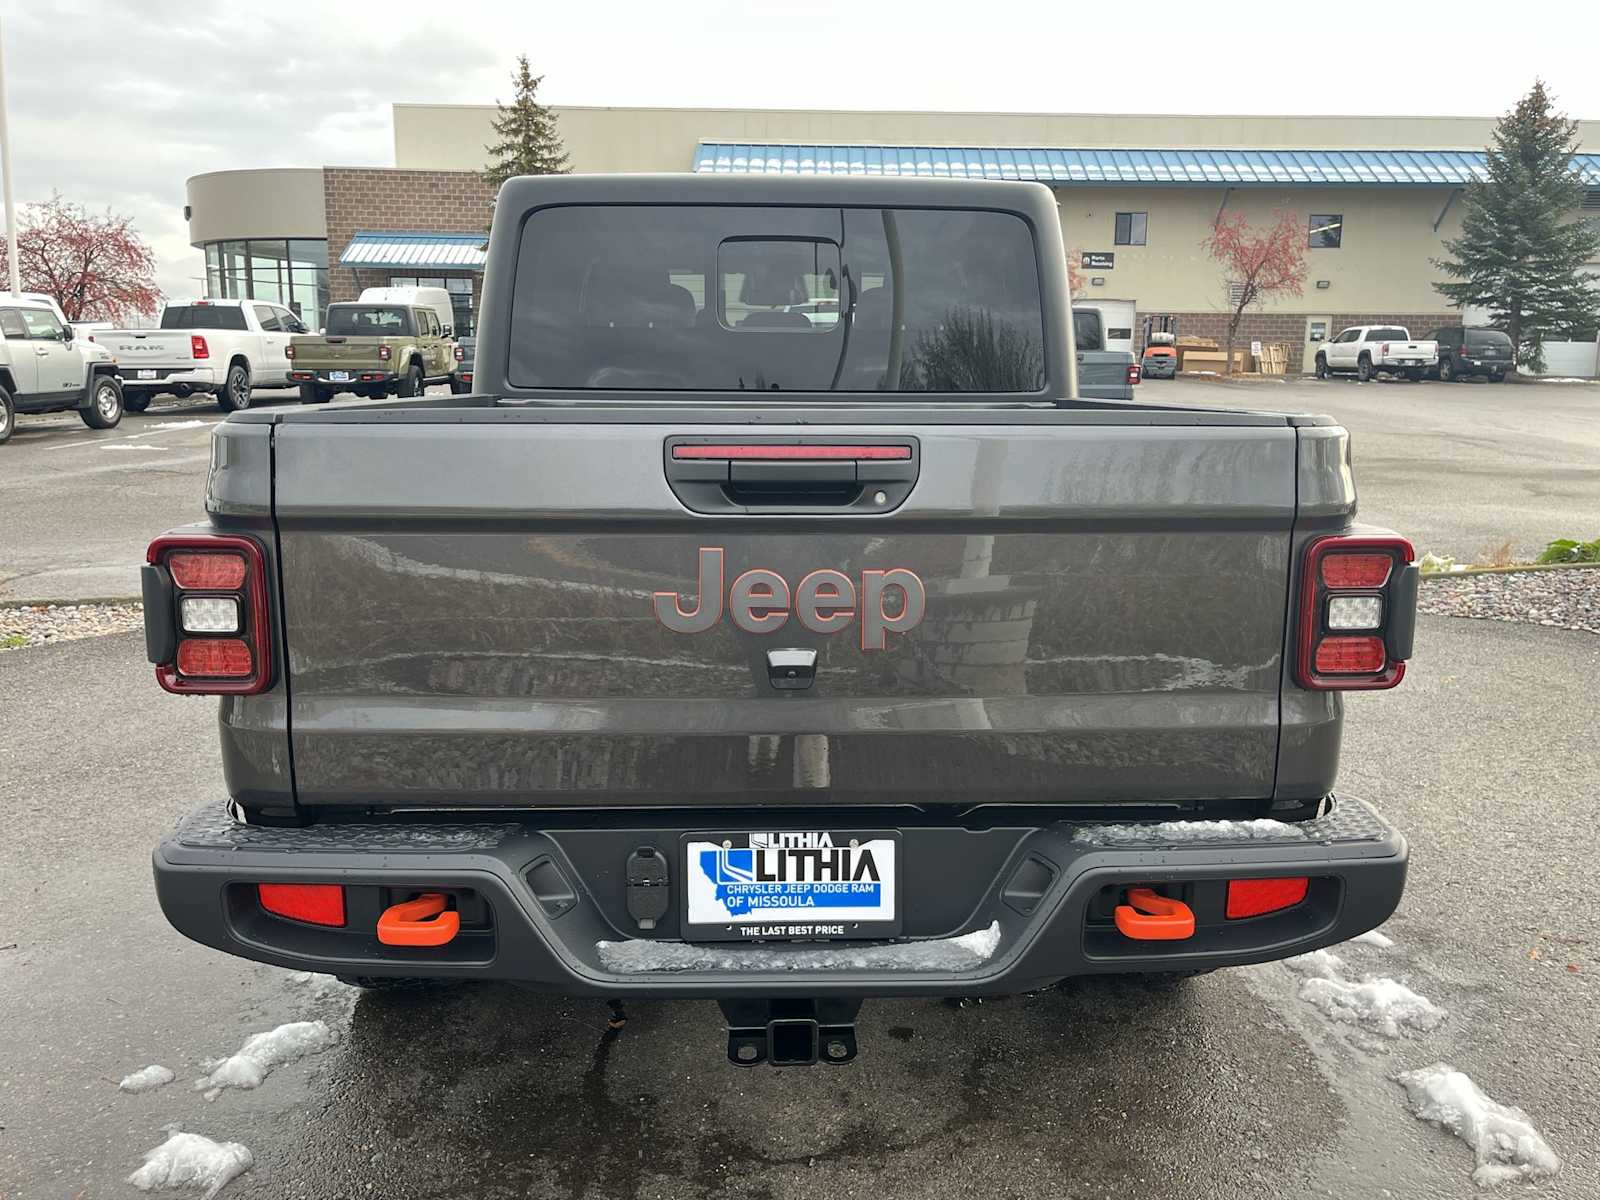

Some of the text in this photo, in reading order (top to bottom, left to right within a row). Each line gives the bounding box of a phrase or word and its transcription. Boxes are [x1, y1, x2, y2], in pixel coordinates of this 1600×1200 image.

[653, 547, 926, 650] Jeep
[769, 832, 834, 848] LITHIA
[756, 849, 881, 882] LITHIA
[726, 884, 874, 895] CHRYSLER JEEP DODGE RAM
[727, 896, 815, 908] OF MISSOULA
[740, 925, 844, 936] THE LAST BEST PRICE
